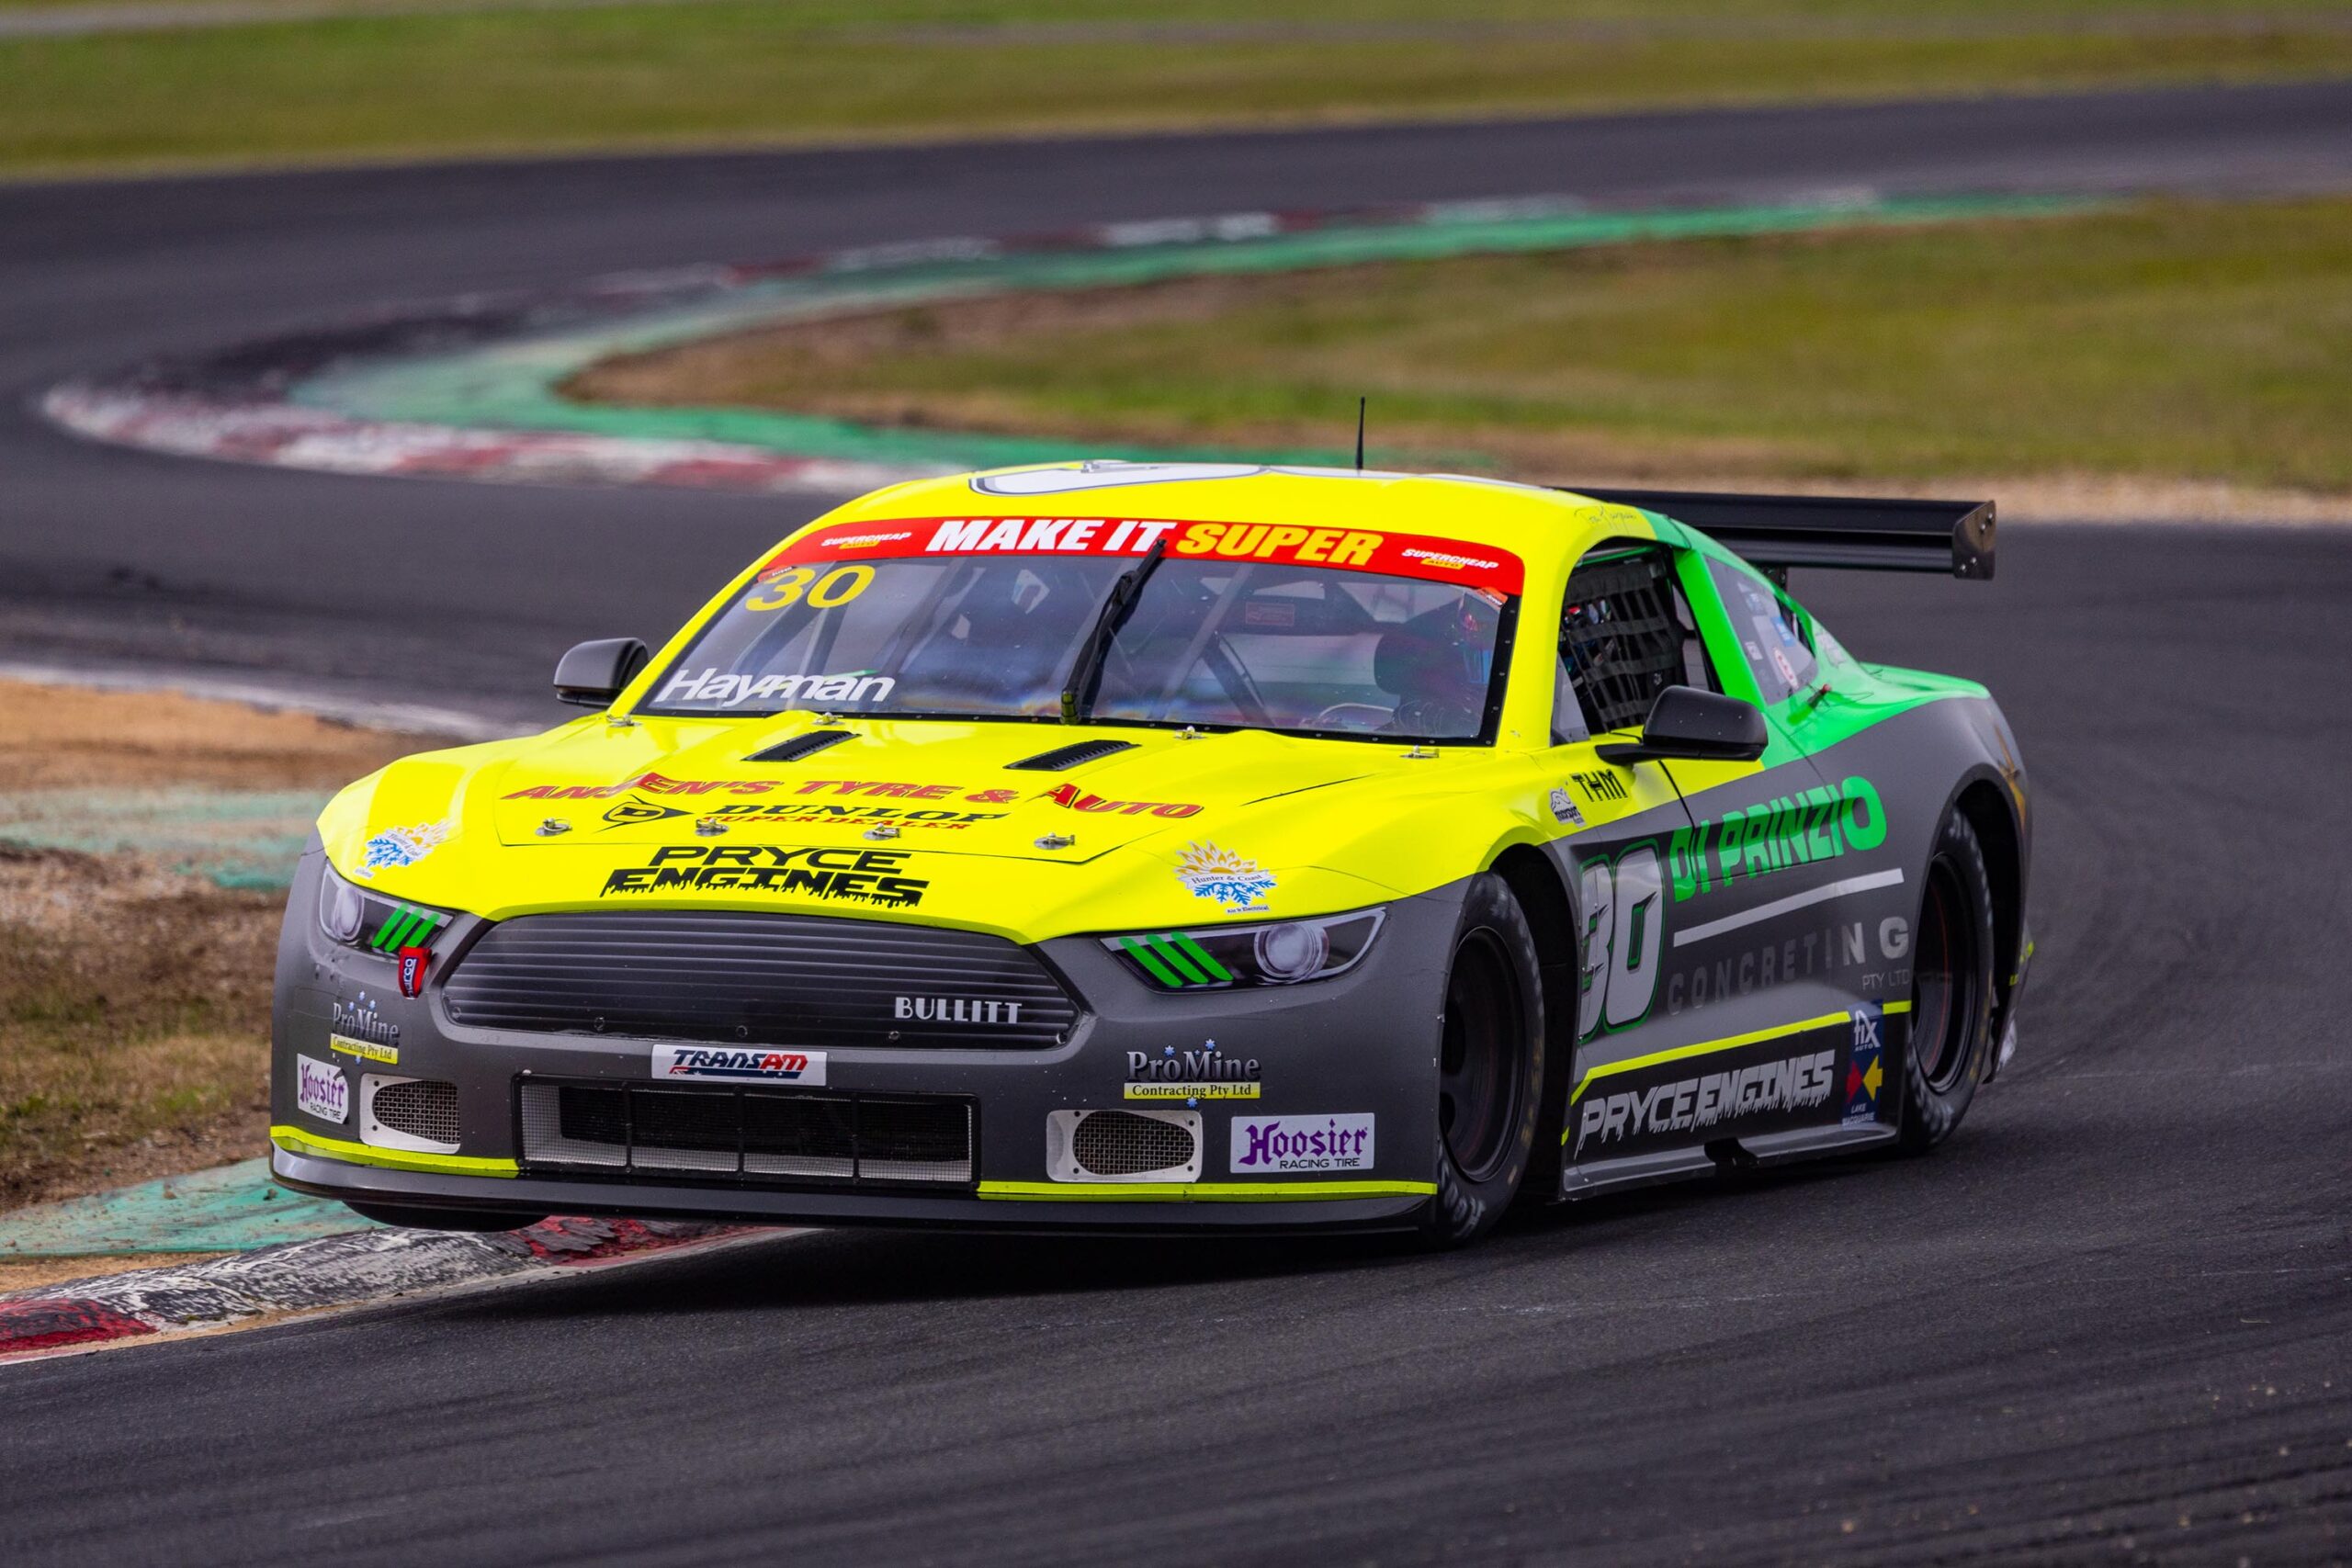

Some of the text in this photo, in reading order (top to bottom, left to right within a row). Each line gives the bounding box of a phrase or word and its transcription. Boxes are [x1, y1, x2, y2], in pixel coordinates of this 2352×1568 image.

[820, 532, 911, 547] SUPERCHEAP
[924, 519, 1385, 566] MAKE IT SUPER
[1401, 548, 1499, 569] SUPERCHEAP
[1428, 559, 1459, 568] AUTO
[745, 565, 876, 612] 30
[654, 668, 896, 707] Hayman
[707, 805, 1012, 822] DUNLOP
[794, 781, 965, 801] TYRE
[964, 788, 1020, 805] &
[1040, 783, 1204, 819] AUTO
[1669, 775, 1887, 903] DI PRINZIO
[648, 845, 912, 874] PRYCE
[599, 867, 931, 908] ENGINES
[1191, 875, 1224, 884] Hunter
[1238, 874, 1263, 882] Coast
[1578, 837, 1665, 1045] 30
[1668, 916, 1909, 1016] CONCRETING
[1862, 968, 1911, 990] PTY LTD
[333, 1002, 400, 1045] ProMine
[895, 997, 1023, 1024] BULLITT
[333, 1036, 392, 1059] Contracting Pty Ltd
[1126, 1050, 1260, 1081] ProMine
[299, 1063, 345, 1109] Hoosier
[1132, 1084, 1251, 1099] Contracting Pty Ltd
[310, 1101, 341, 1120] RACING TIRE
[1238, 1118, 1367, 1166] Hoosier
[1280, 1157, 1360, 1169] RACING TIRE
